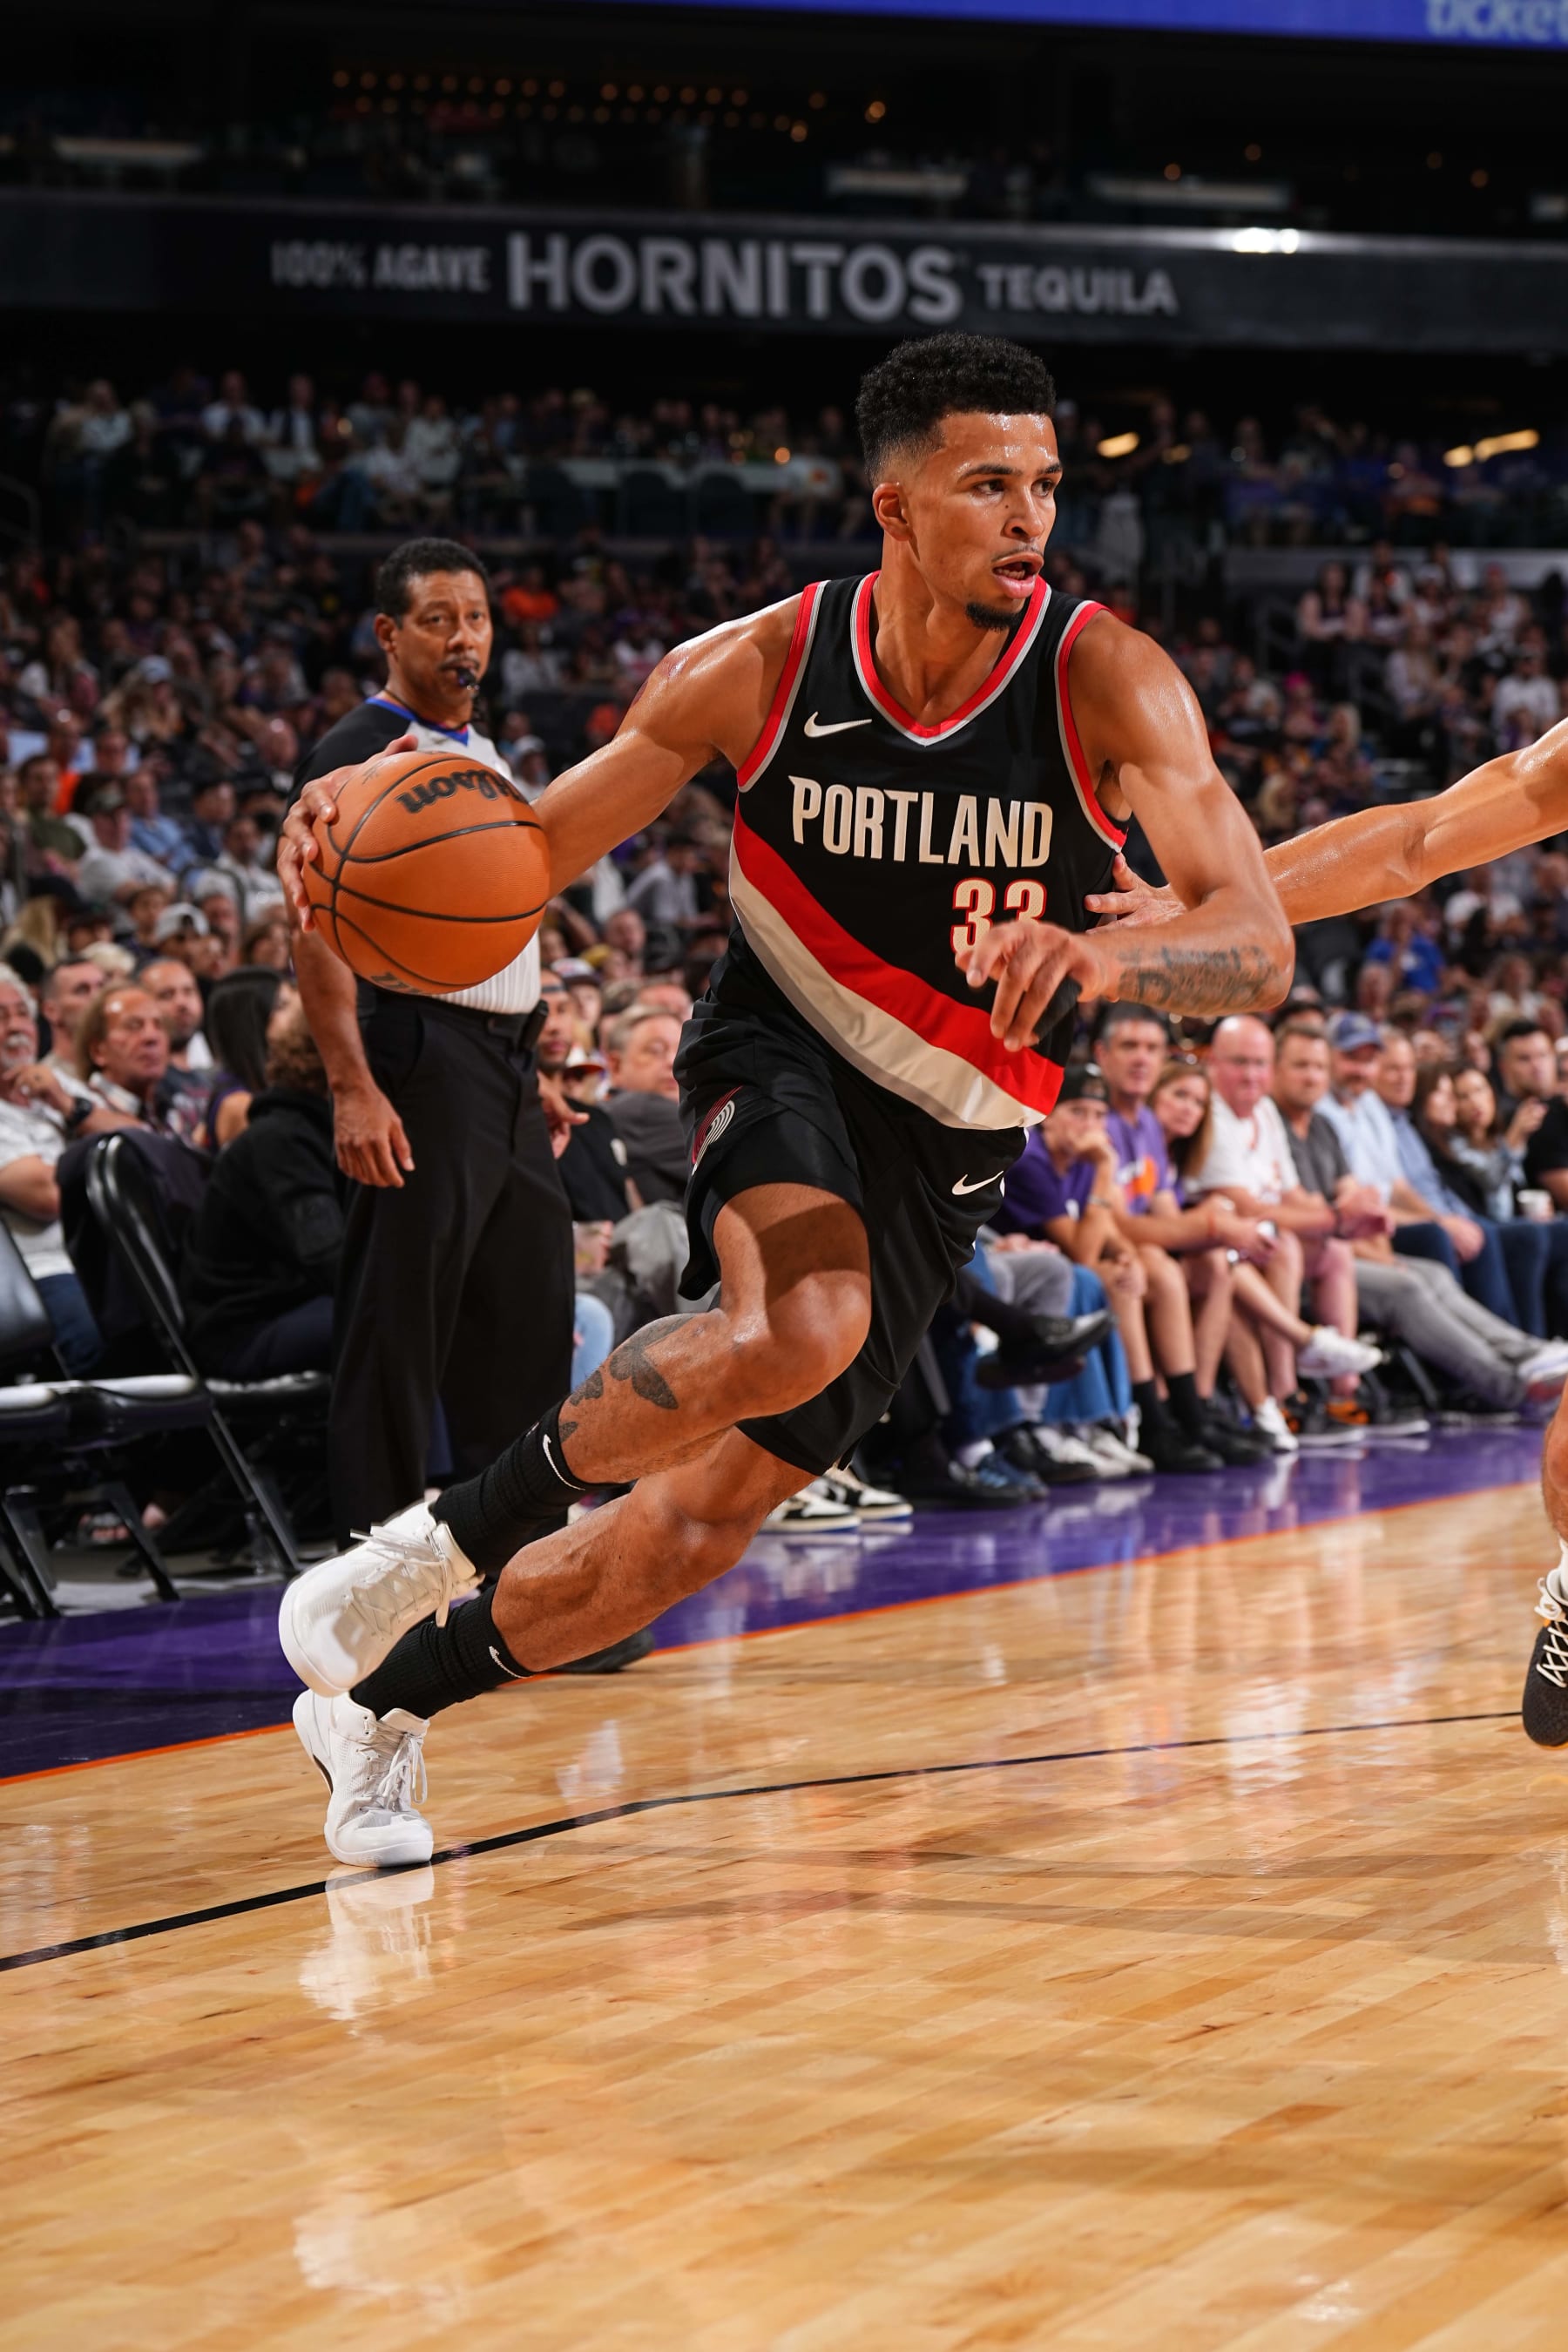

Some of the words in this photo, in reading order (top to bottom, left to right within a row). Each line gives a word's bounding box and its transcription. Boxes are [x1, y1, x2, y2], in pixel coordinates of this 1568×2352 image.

[1426, 0, 1568, 43] ticke
[270, 240, 366, 289] 100%
[373, 243, 492, 293] AGAVE
[508, 232, 962, 324] HORNITOS
[977, 264, 1179, 315] TEQUILA
[787, 774, 1053, 868] PORTLAND
[950, 877, 1047, 954] 33
